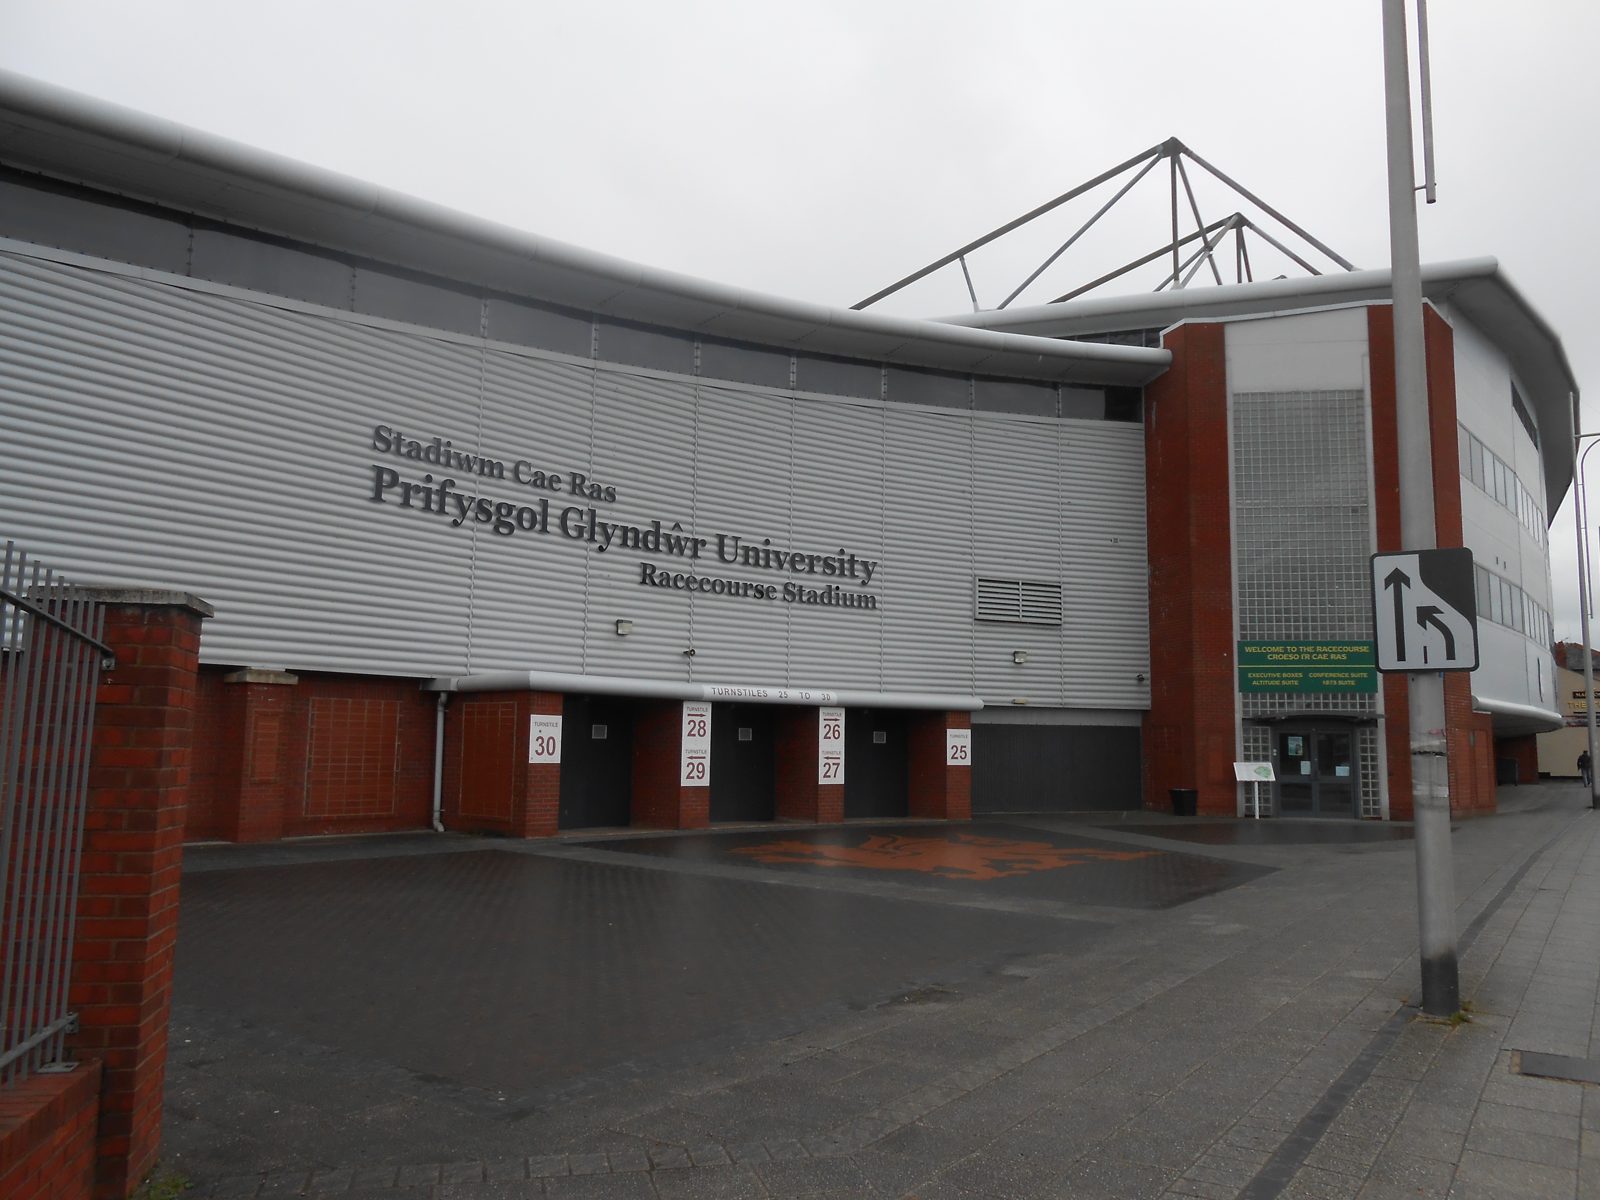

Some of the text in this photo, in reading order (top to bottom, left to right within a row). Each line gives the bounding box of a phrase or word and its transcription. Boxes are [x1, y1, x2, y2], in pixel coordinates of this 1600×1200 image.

[372, 425, 617, 503] Stadiwm Cae Ras
[369, 464, 878, 586] Prifysgol Glyndŵr University
[639, 562, 877, 610] Racecourse Stadium
[712, 687, 831, 701] TURNSTILES 25 TO 30
[687, 719, 707, 738] 28
[823, 723, 841, 740] 26
[535, 735, 556, 756] 30
[950, 744, 967, 760] 25
[685, 761, 706, 780] 29
[822, 762, 841, 779] 27
